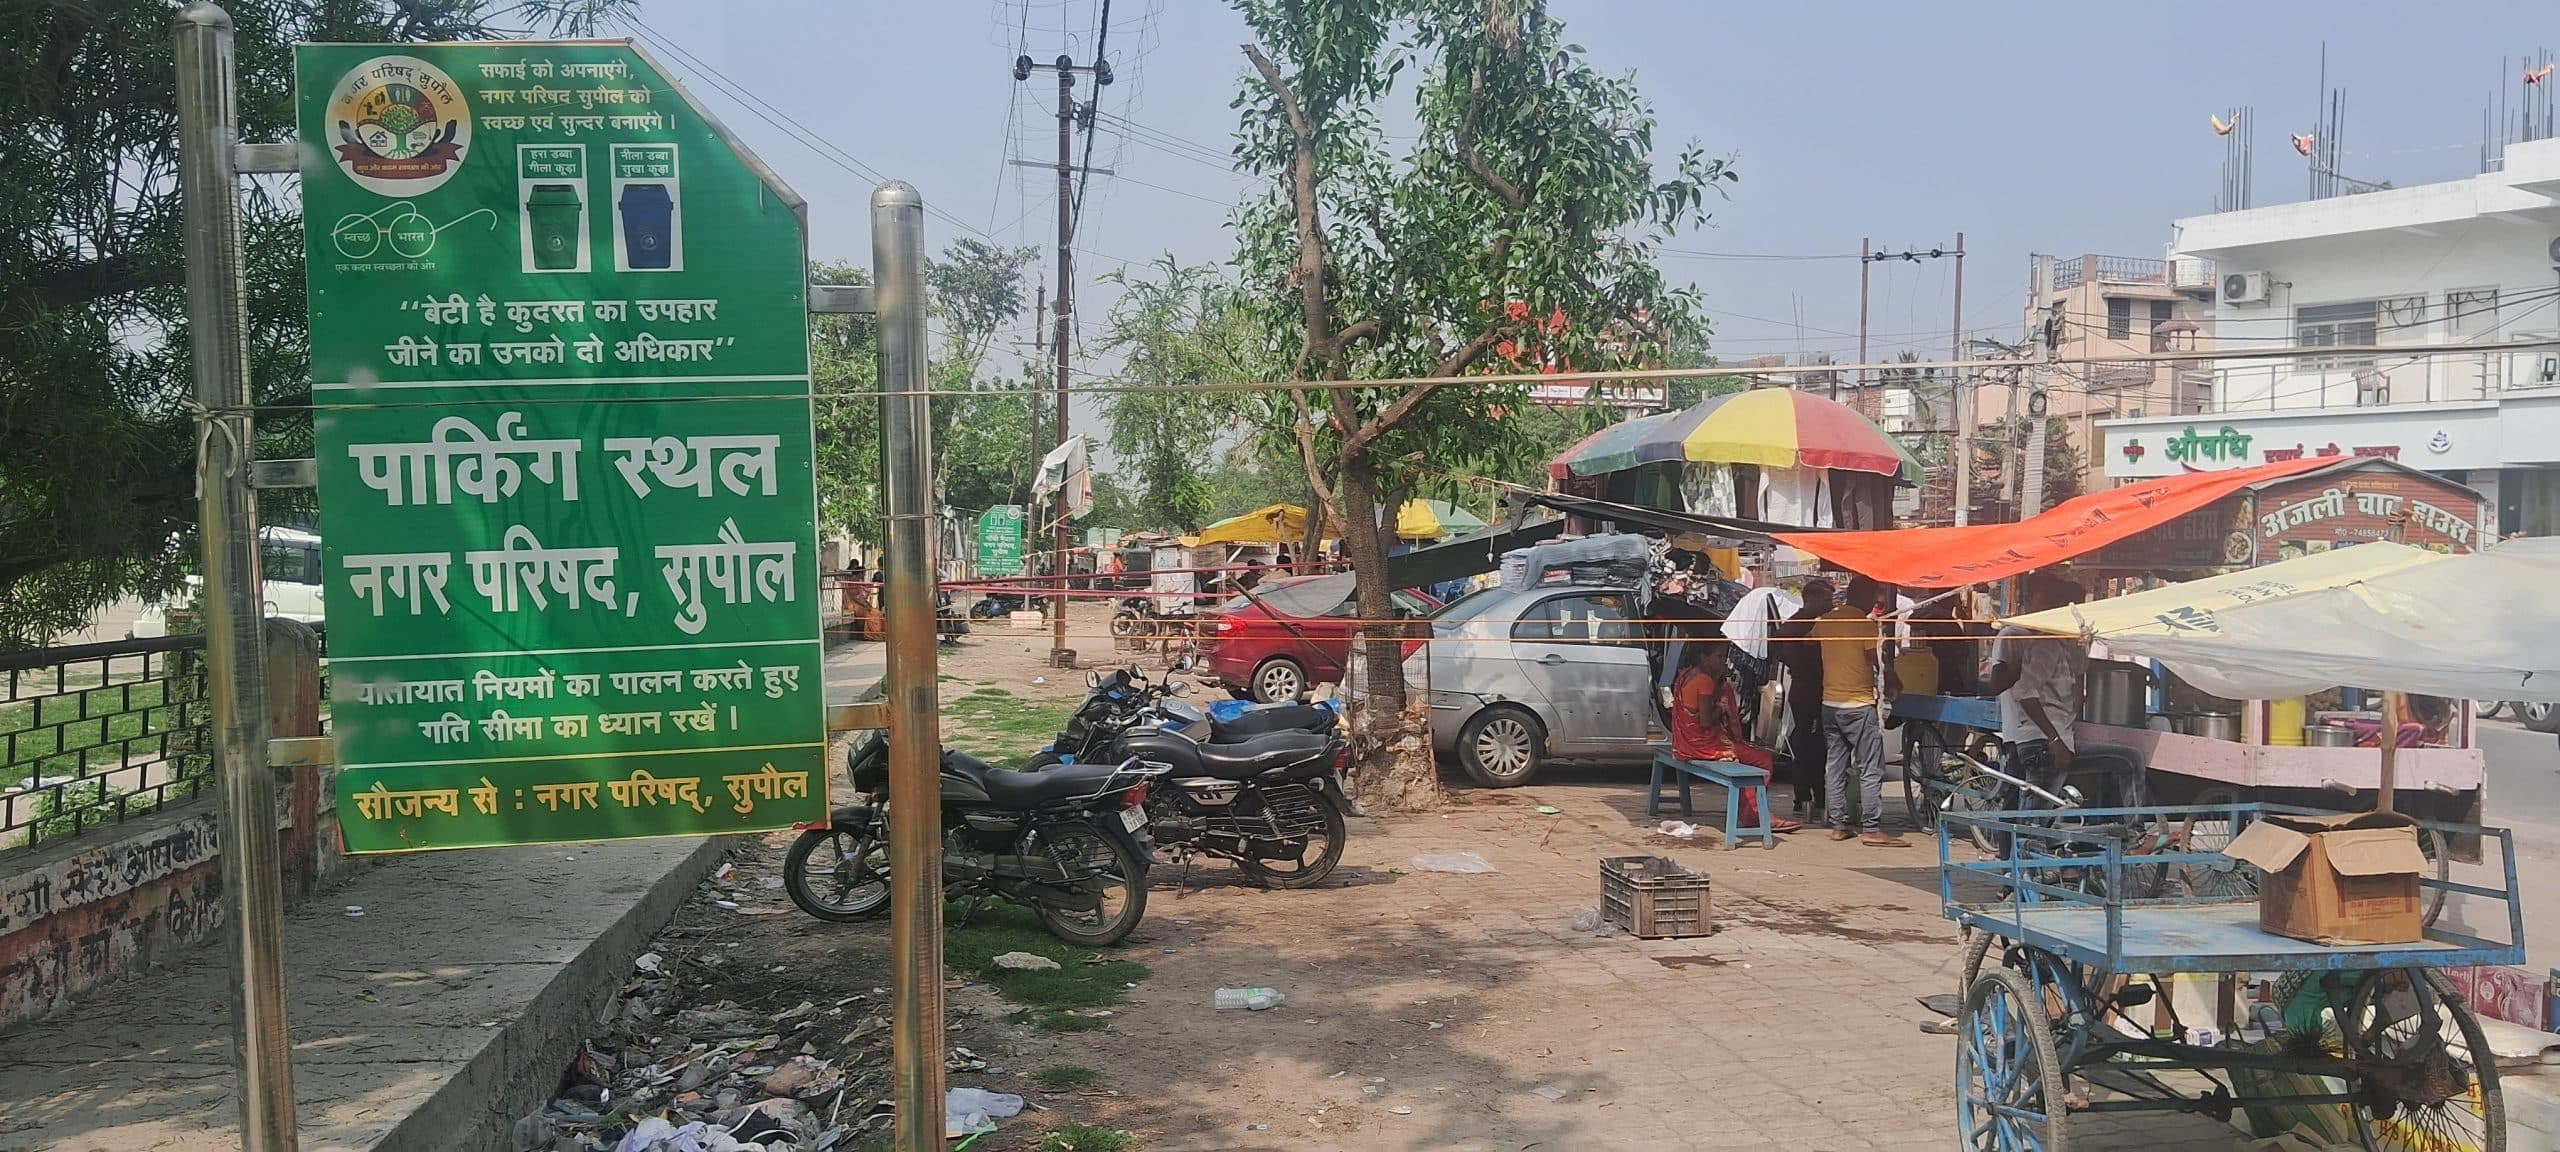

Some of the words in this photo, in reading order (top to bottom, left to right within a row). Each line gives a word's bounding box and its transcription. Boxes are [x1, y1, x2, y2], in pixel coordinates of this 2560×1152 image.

[371, 62, 413, 83] परिषद्
[418, 71, 453, 106] सुपौल
[479, 59, 526, 80] सफाई
[531, 60, 553, 78] को
[561, 60, 635, 80] अपनाएंगे,
[479, 89, 515, 105] नगर
[520, 85, 571, 104] परिषद
[576, 85, 624, 110] सुपौल
[629, 85, 651, 104] को
[480, 115, 525, 130] स्वच्छ
[530, 112, 553, 132] एवं
[559, 116, 605, 136] सुन्दर
[609, 111, 663, 132] बनाएंगे
[529, 162, 552, 173] गीला
[531, 149, 548, 160] हरा
[551, 149, 574, 160] डब्बा
[620, 148, 645, 161] नीला
[647, 150, 670, 161] डब्बा
[344, 232, 371, 243] स्वच्छ
[397, 231, 425, 243] भारत
[335, 263, 350, 276] एक
[352, 263, 371, 274] कदम
[374, 263, 405, 273] स्वच्छता
[477, 293, 496, 325] है
[505, 301, 584, 332] कुदरत
[592, 300, 628, 323] का
[638, 299, 718, 322] उपहार
[385, 335, 438, 366] जीने
[448, 341, 482, 366] का
[492, 336, 566, 363] उनको
[575, 336, 605, 362] दो
[348, 411, 582, 506] पार्किंग
[603, 433, 782, 500] स्थल
[2164, 425, 2253, 462] औषधि
[2261, 488, 2347, 538] अंजली
[2411, 500, 2475, 545] हाउस
[343, 552, 452, 617] नगर
[465, 524, 640, 618] परिषद,
[654, 517, 797, 634] सुपौल
[354, 676, 464, 706] यातायात
[472, 667, 555, 702] नियमों
[564, 673, 600, 697] का
[609, 669, 683, 697] पालन
[690, 659, 753, 692] करते
[762, 665, 801, 698] हुए
[418, 712, 470, 744] गति
[479, 712, 542, 741] सीमा
[553, 714, 588, 738] का
[597, 711, 662, 736] ध्यान
[669, 702, 717, 733] रखें
[353, 780, 459, 821] सौजन्य
[468, 776, 499, 816] से
[532, 783, 599, 812] नगर
[722, 762, 809, 813] सुपौल
